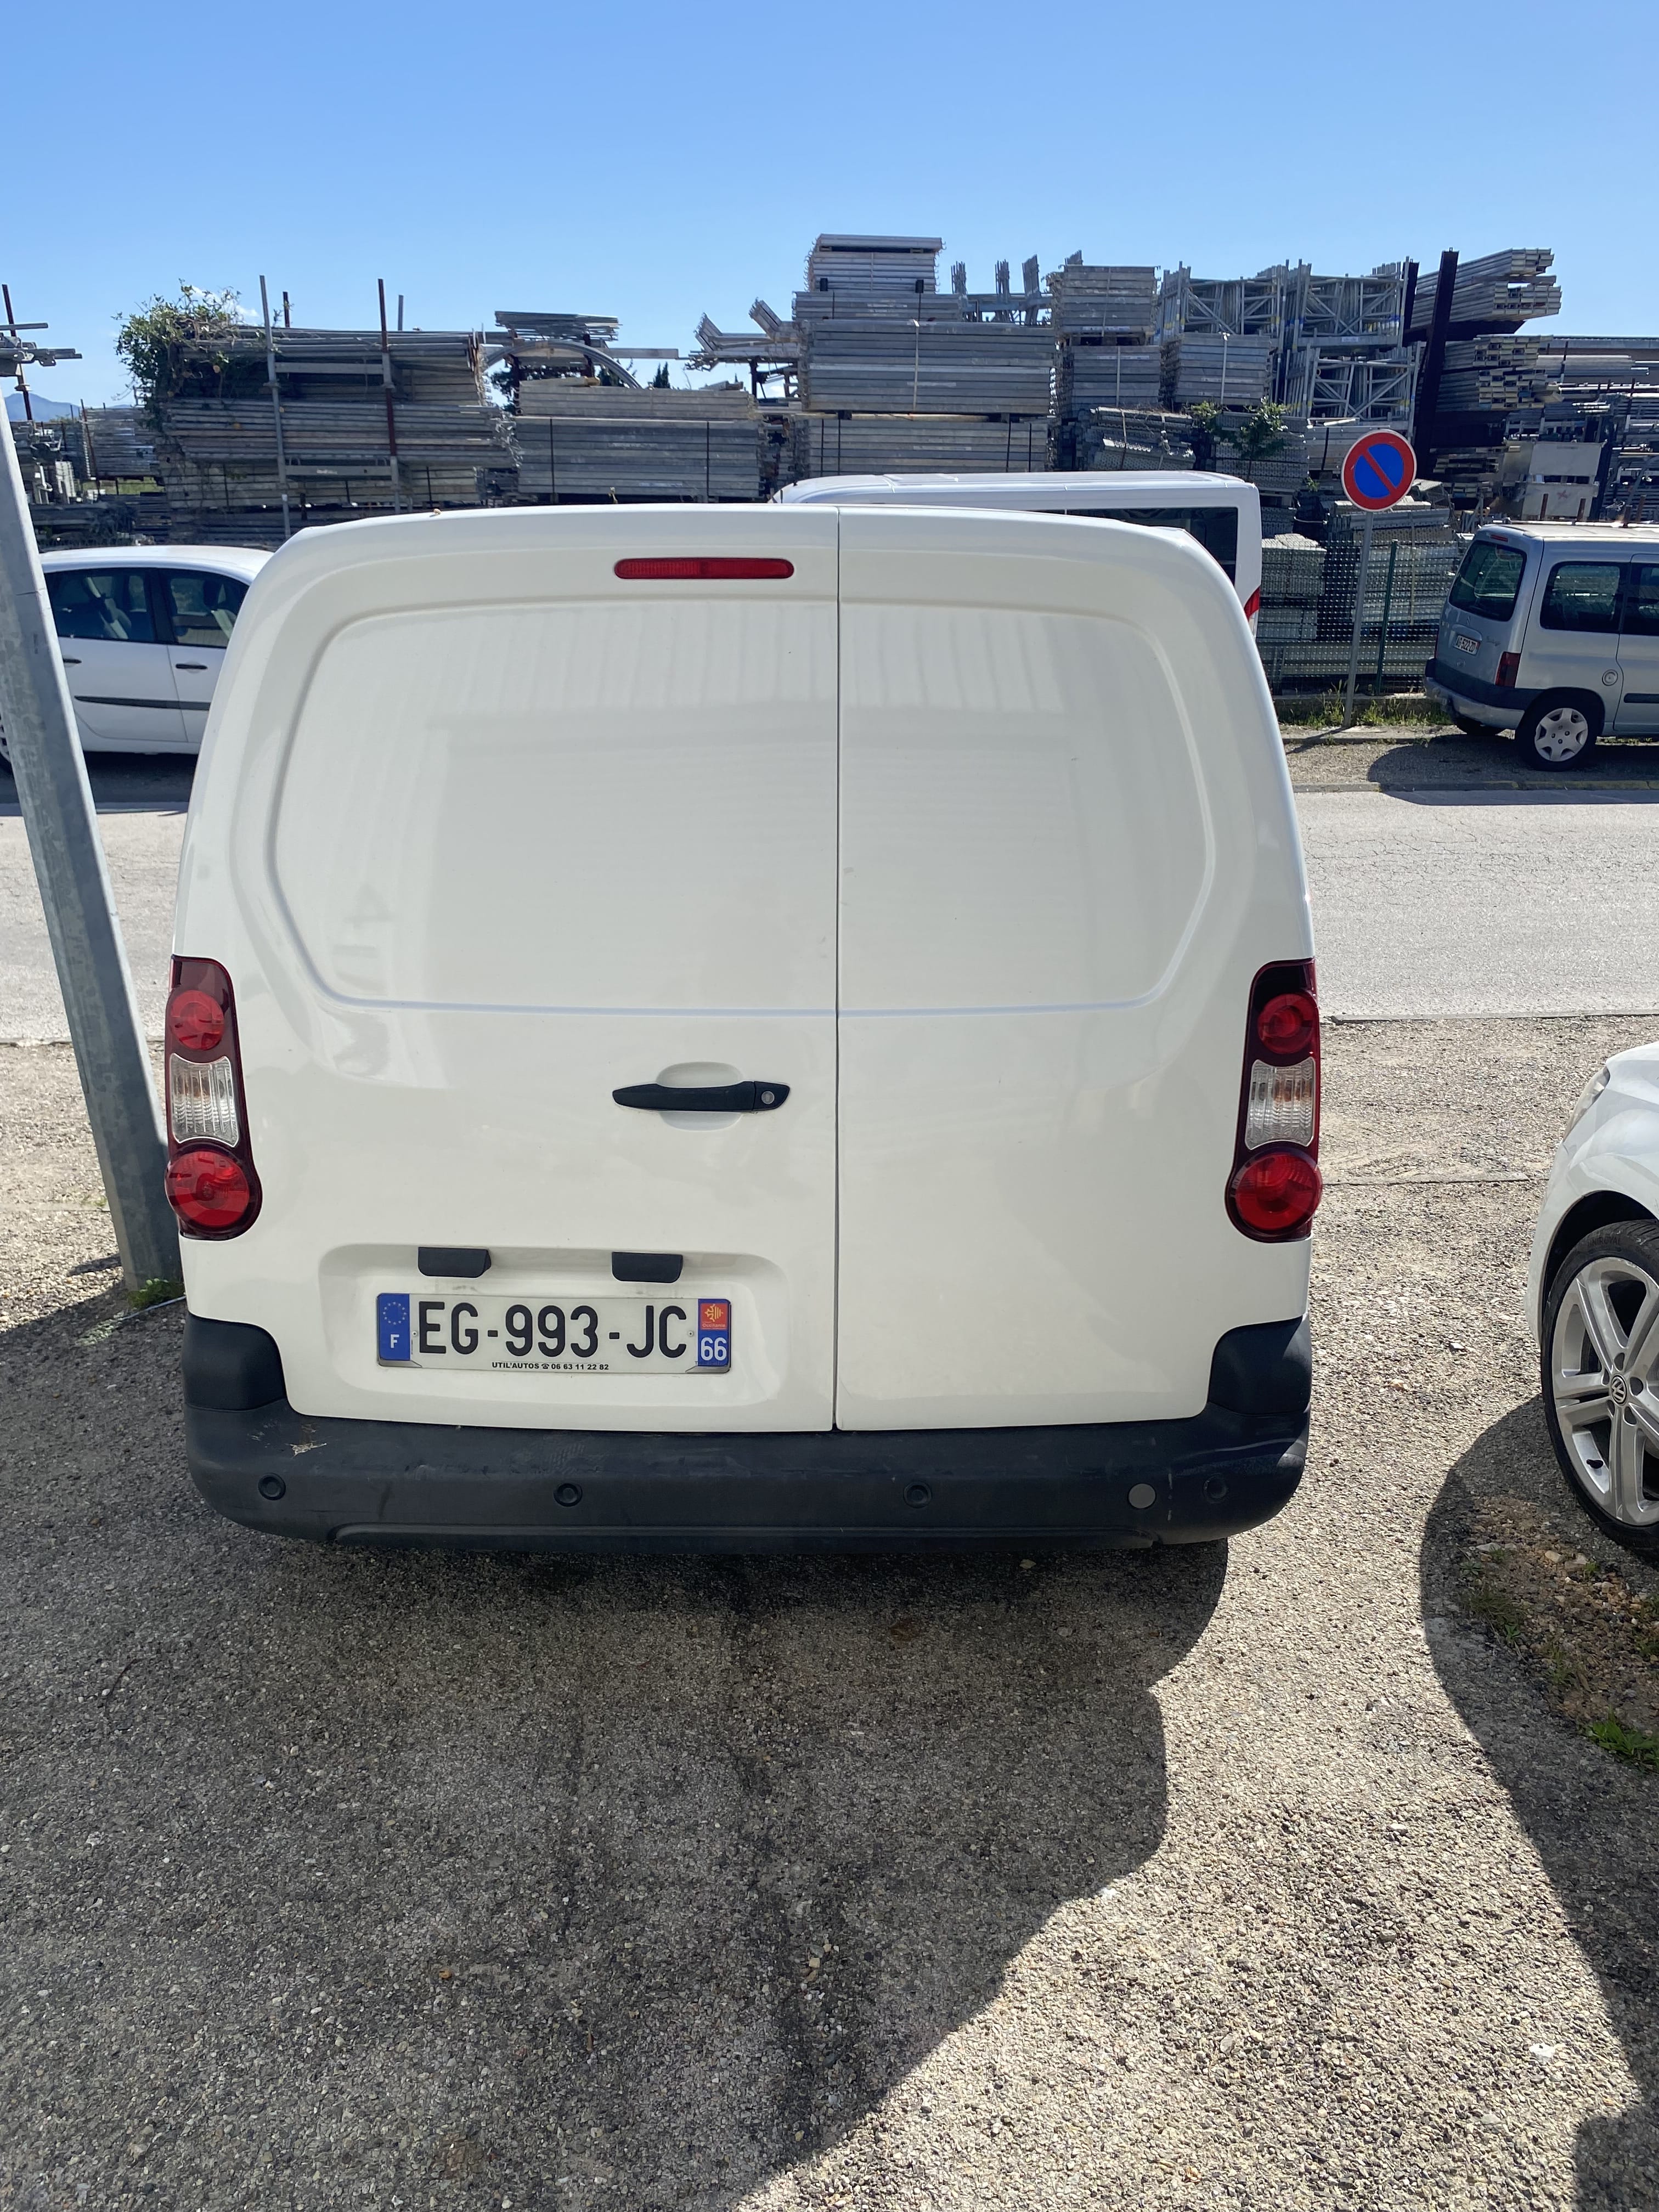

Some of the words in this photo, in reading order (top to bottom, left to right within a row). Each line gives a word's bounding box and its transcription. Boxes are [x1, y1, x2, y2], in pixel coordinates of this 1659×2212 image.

[390, 1334, 399, 1348] F
[419, 1301, 687, 1358] EG-993-JC
[701, 1337, 727, 1361] 66
